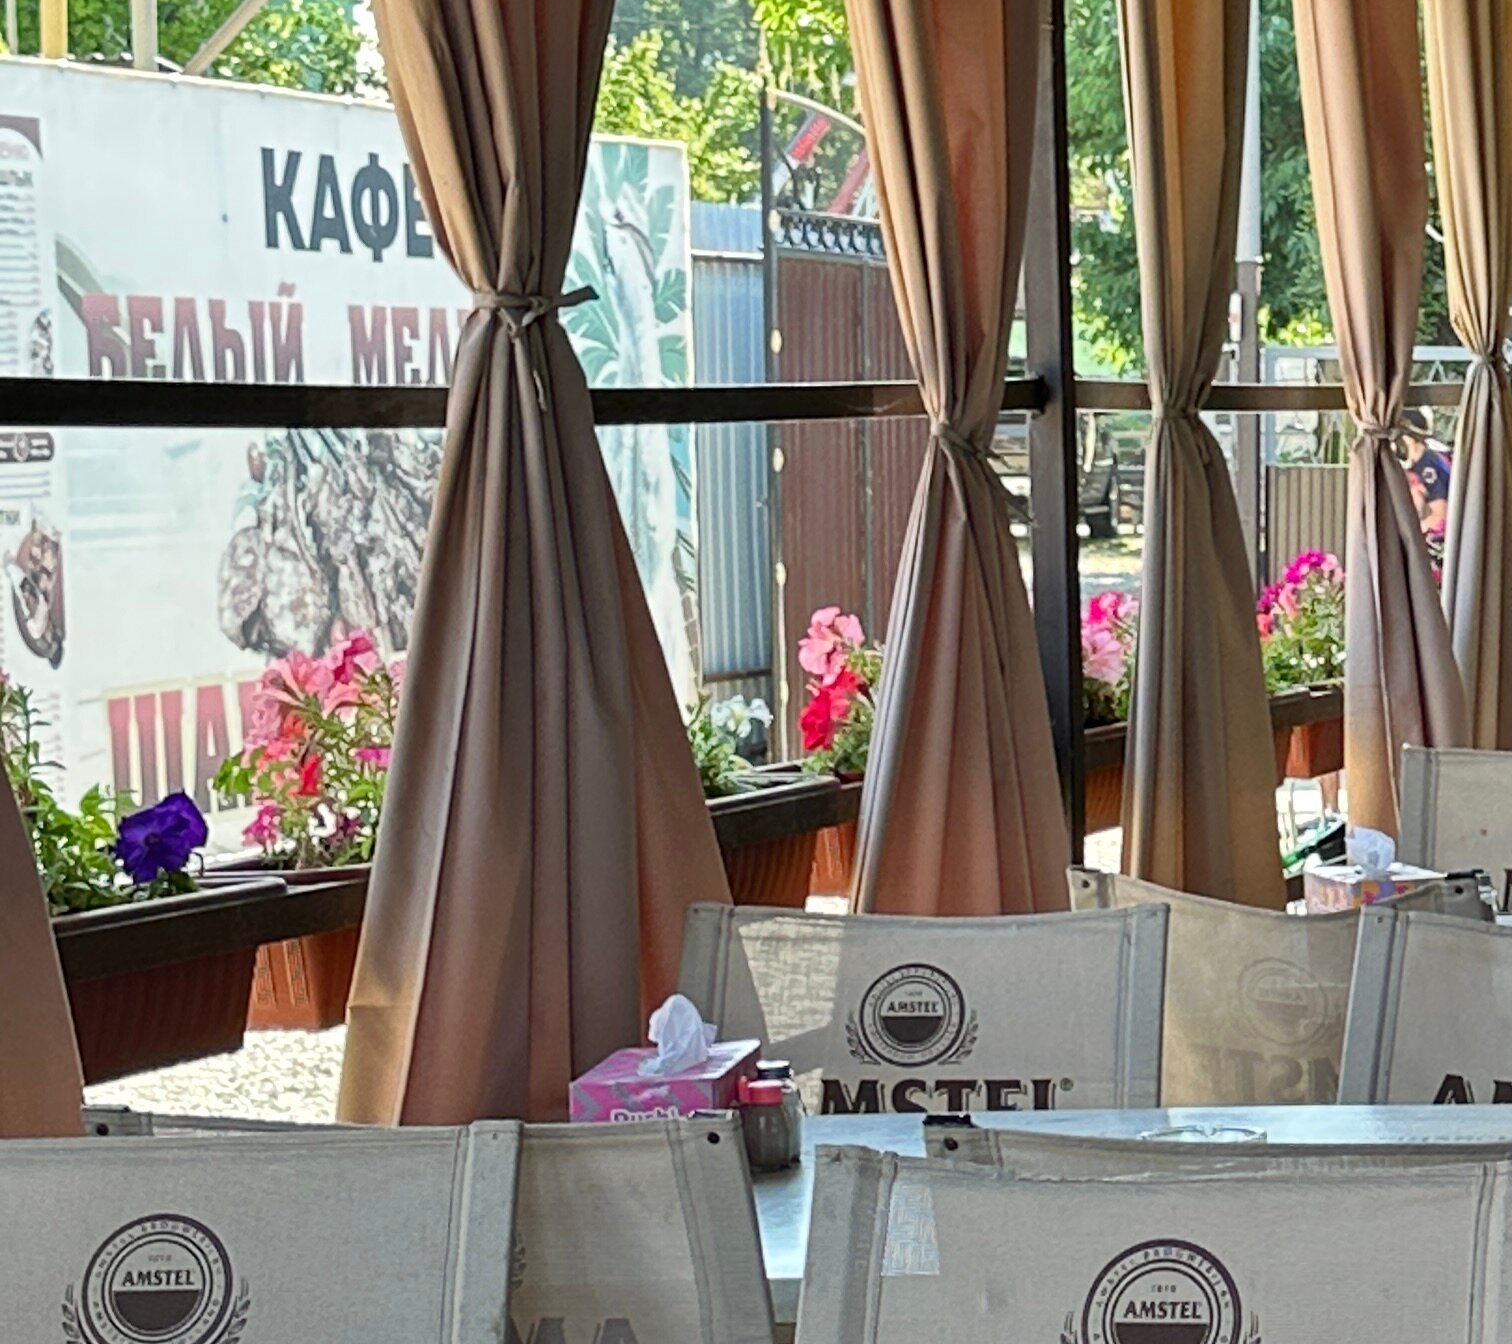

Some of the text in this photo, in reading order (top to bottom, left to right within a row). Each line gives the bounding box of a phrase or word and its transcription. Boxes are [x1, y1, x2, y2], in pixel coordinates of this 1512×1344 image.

[81, 282, 304, 382] БЕЛЫЙ
[886, 1001, 939, 1014] AMSTEL
[820, 1078, 1059, 1116] MSTEL
[122, 1270, 195, 1287] AMSTEL
[1123, 1300, 1203, 1319] AMSTEL
